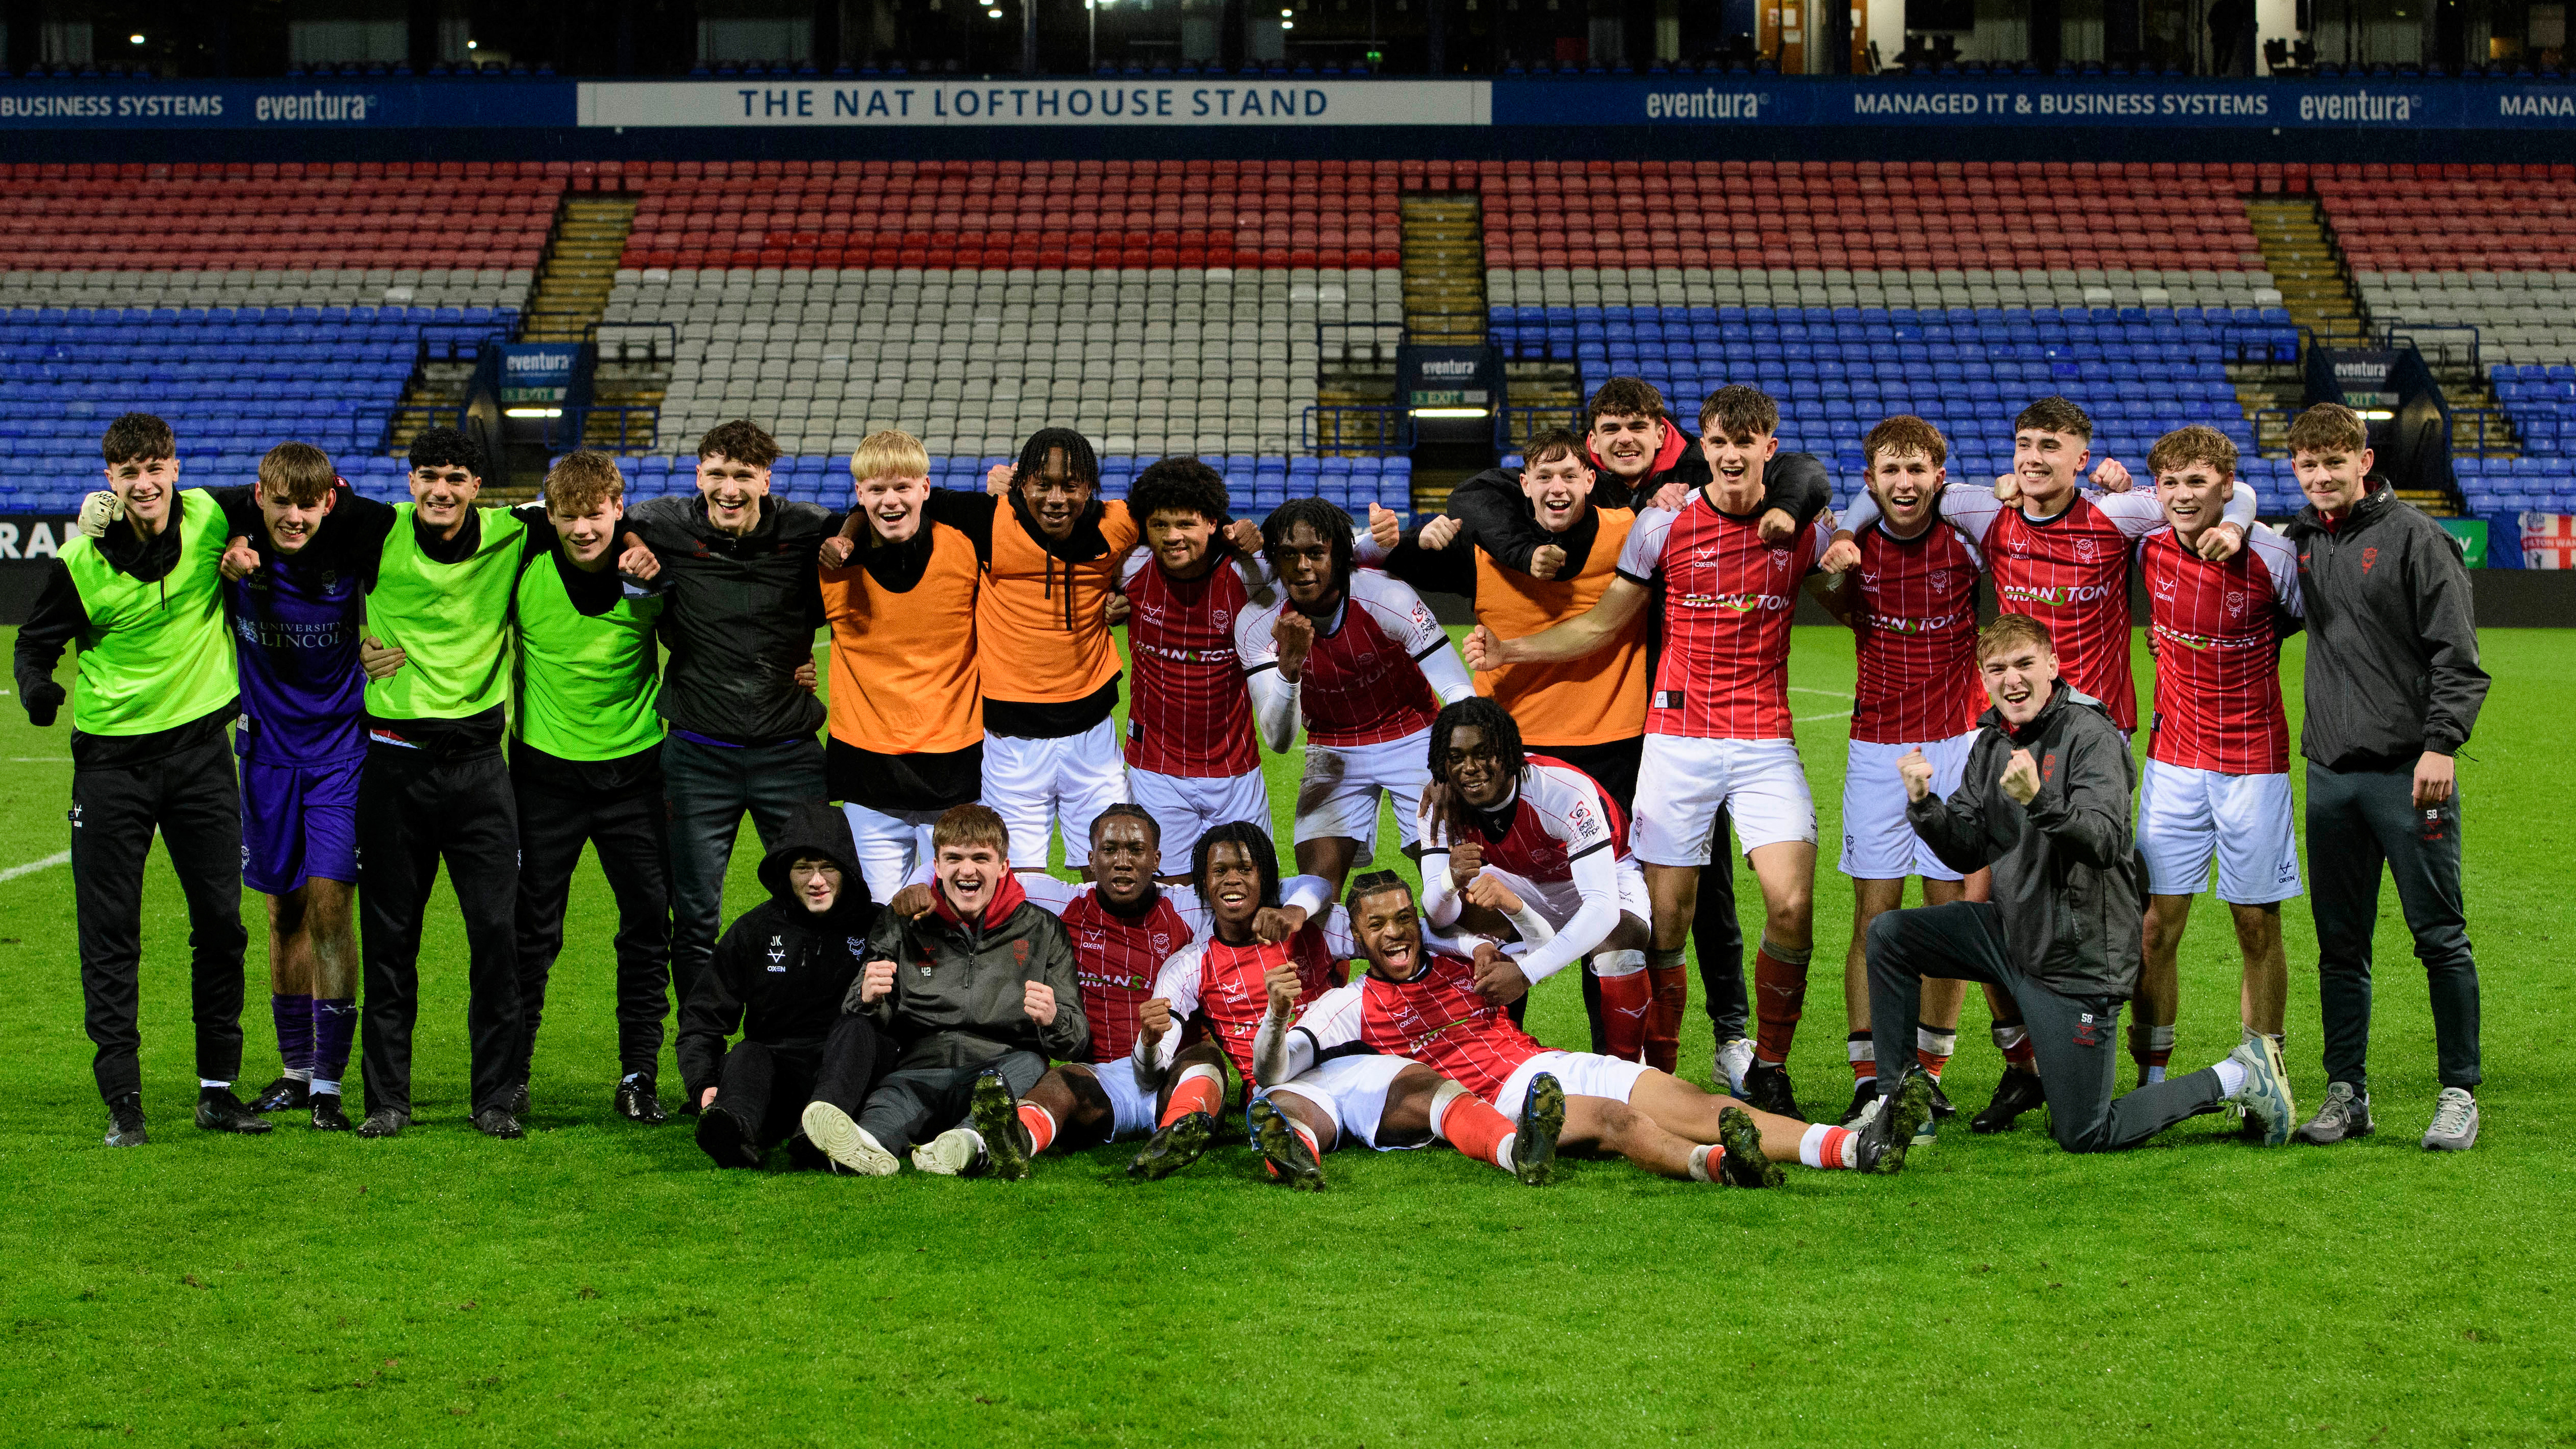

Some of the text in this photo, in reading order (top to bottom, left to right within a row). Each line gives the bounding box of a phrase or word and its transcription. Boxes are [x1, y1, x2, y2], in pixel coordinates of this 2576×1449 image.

[1, 95, 223, 116] BUSINESS SYSTEMS
[256, 90, 366, 121] eventura
[738, 89, 1328, 117] THE NAT LOFTHOUSE STAND
[1646, 87, 1758, 118] eventura
[1854, 94, 2268, 116] MANAGED IT & BUSINESS SYSTEMS
[2300, 90, 2410, 121] eventura
[507, 351, 569, 371] eventura
[1421, 359, 1475, 375] eventura
[2334, 361, 2386, 377] eventura
[1860, 584, 1879, 593] OXEN
[2003, 581, 2111, 607] BRANSTON
[2156, 591, 2172, 603] OXEN
[1681, 593, 1790, 612] BRANSTON
[1143, 615, 1162, 626] OXEN
[1857, 611, 1961, 635] RANSTON
[260, 632, 342, 649] LINCOL
[2279, 875, 2295, 883] OXEN
[770, 935, 783, 946] JK
[1082, 942, 1103, 950] OXEN
[921, 967, 931, 976] 42
[1078, 971, 1151, 991] BRANS
[1226, 992, 1247, 1004] OXEN
[1400, 1014, 1419, 1028] OXEN
